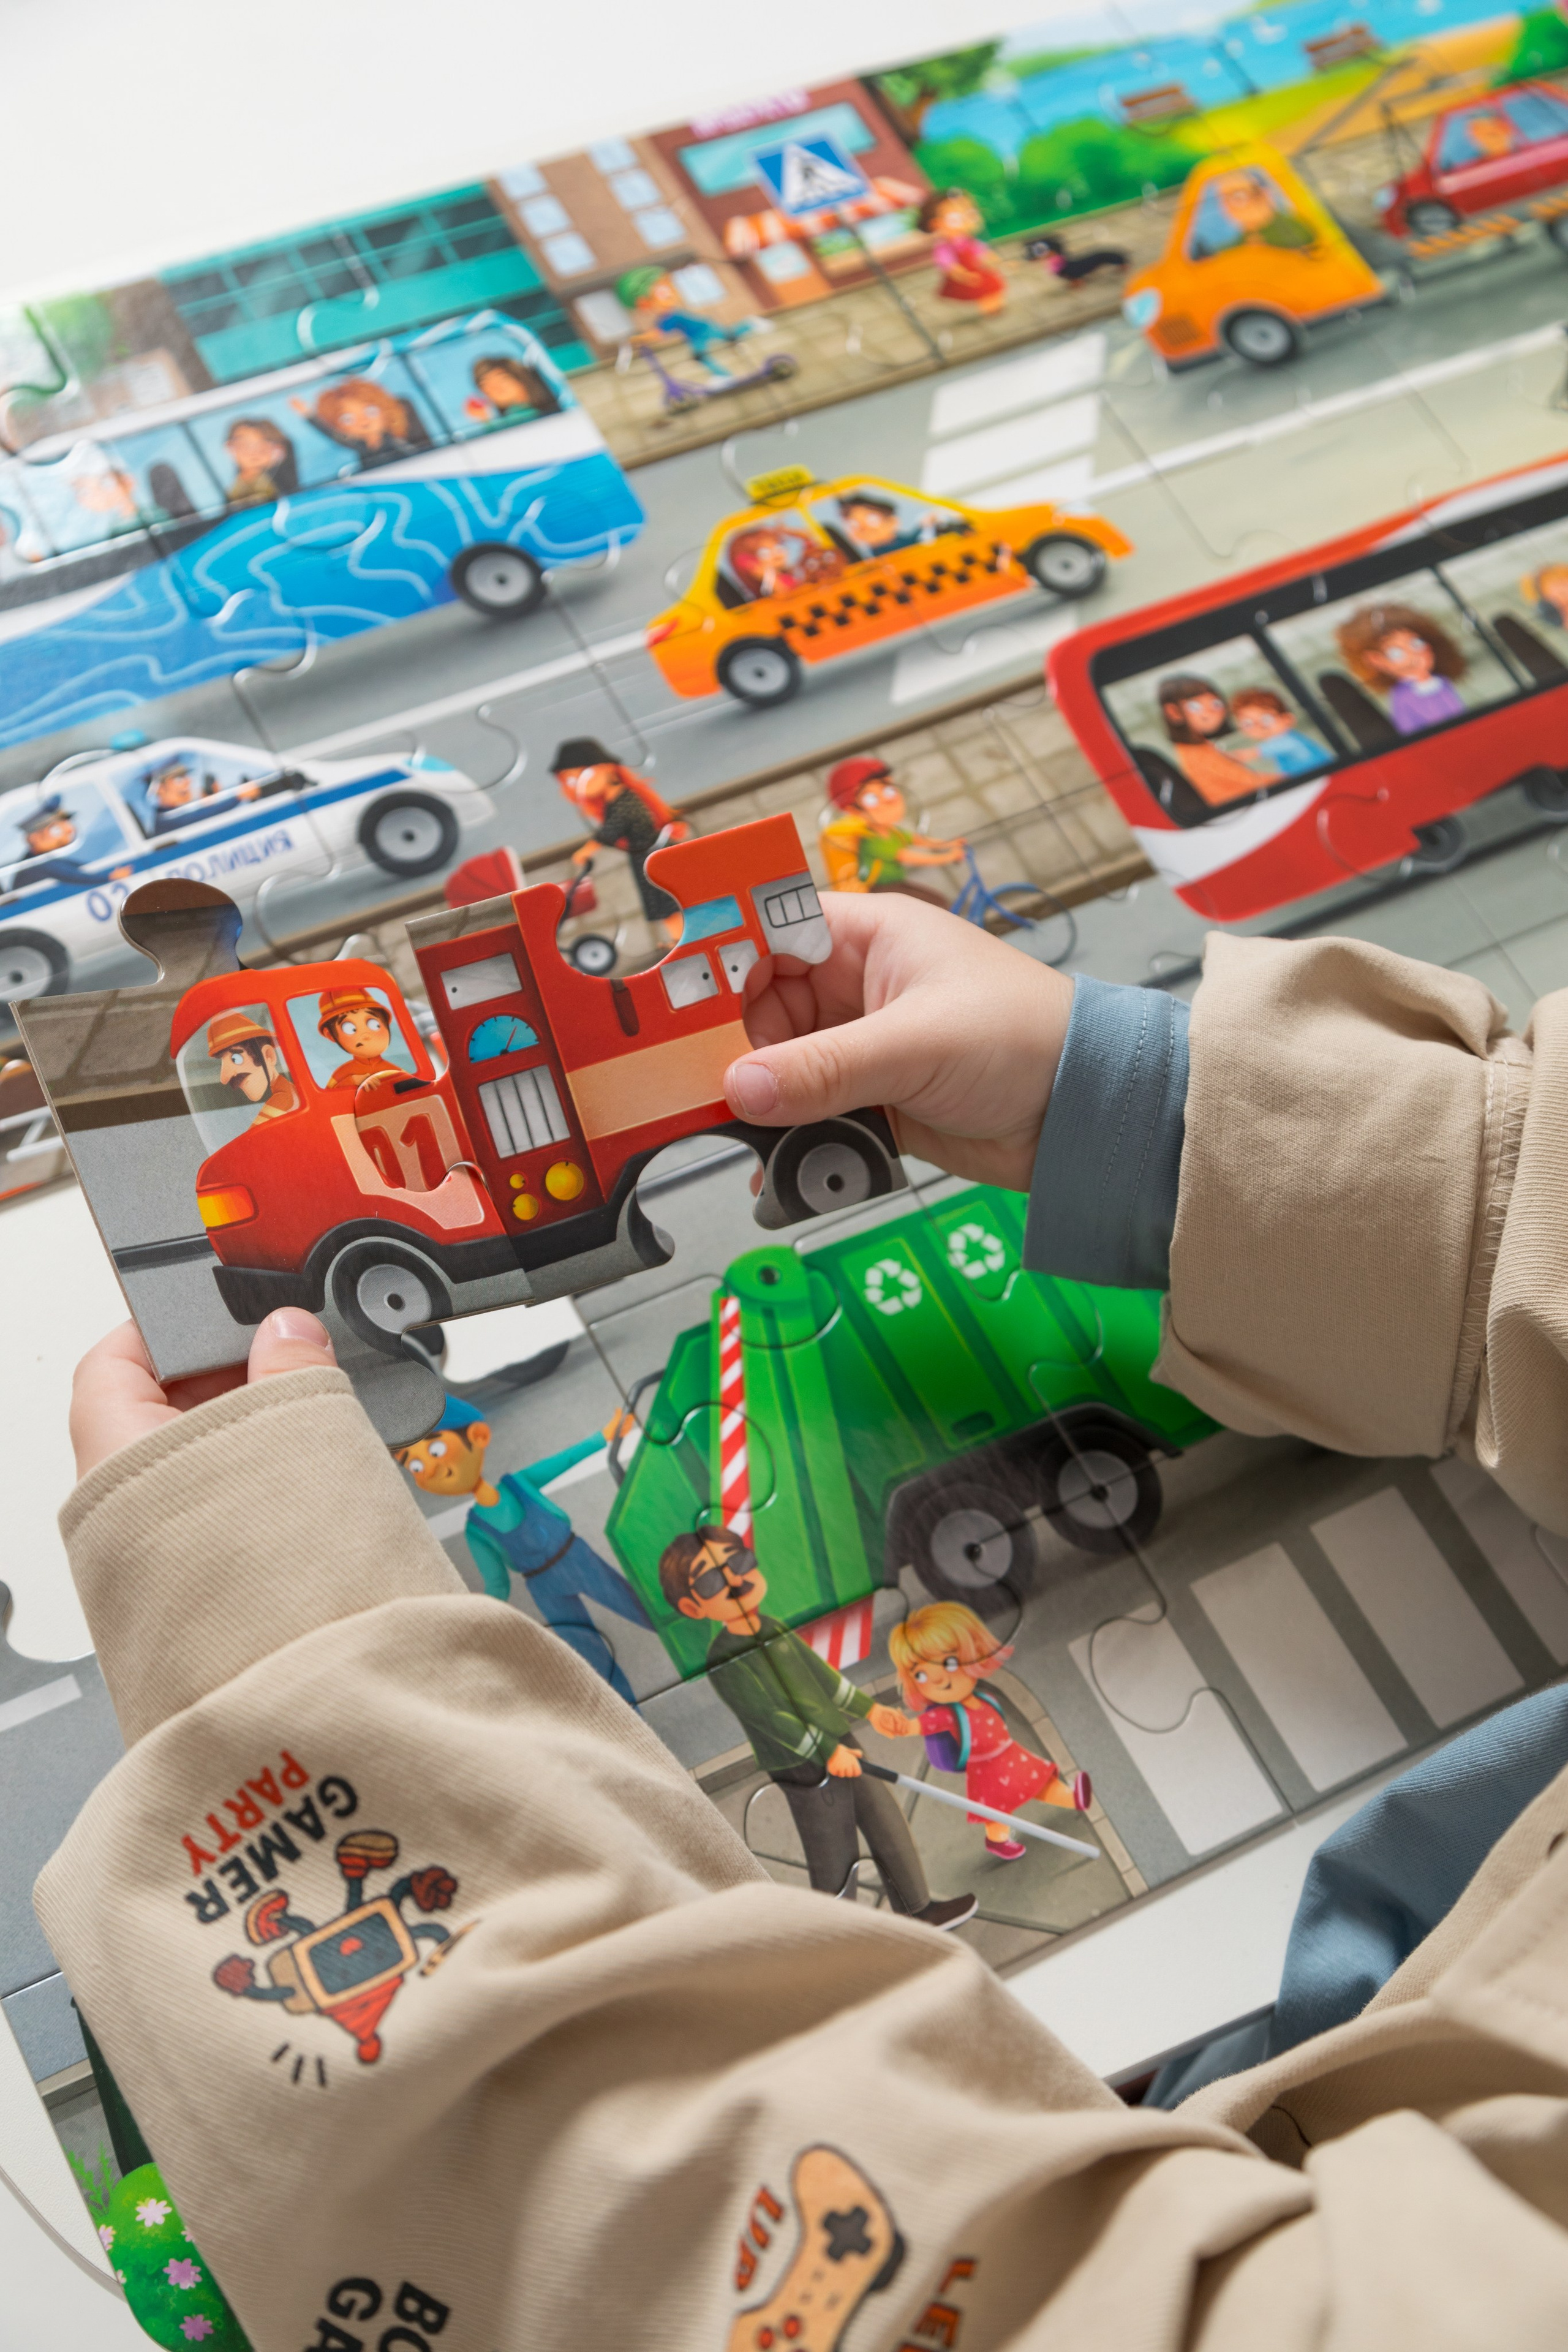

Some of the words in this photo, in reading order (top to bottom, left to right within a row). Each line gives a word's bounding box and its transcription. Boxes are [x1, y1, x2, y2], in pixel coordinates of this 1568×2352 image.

[182, 1749, 311, 1877] PARTY
[185, 1775, 359, 1924] GAMER
[735, 2185, 785, 2291] UP
[898, 2257, 976, 2352] LE
